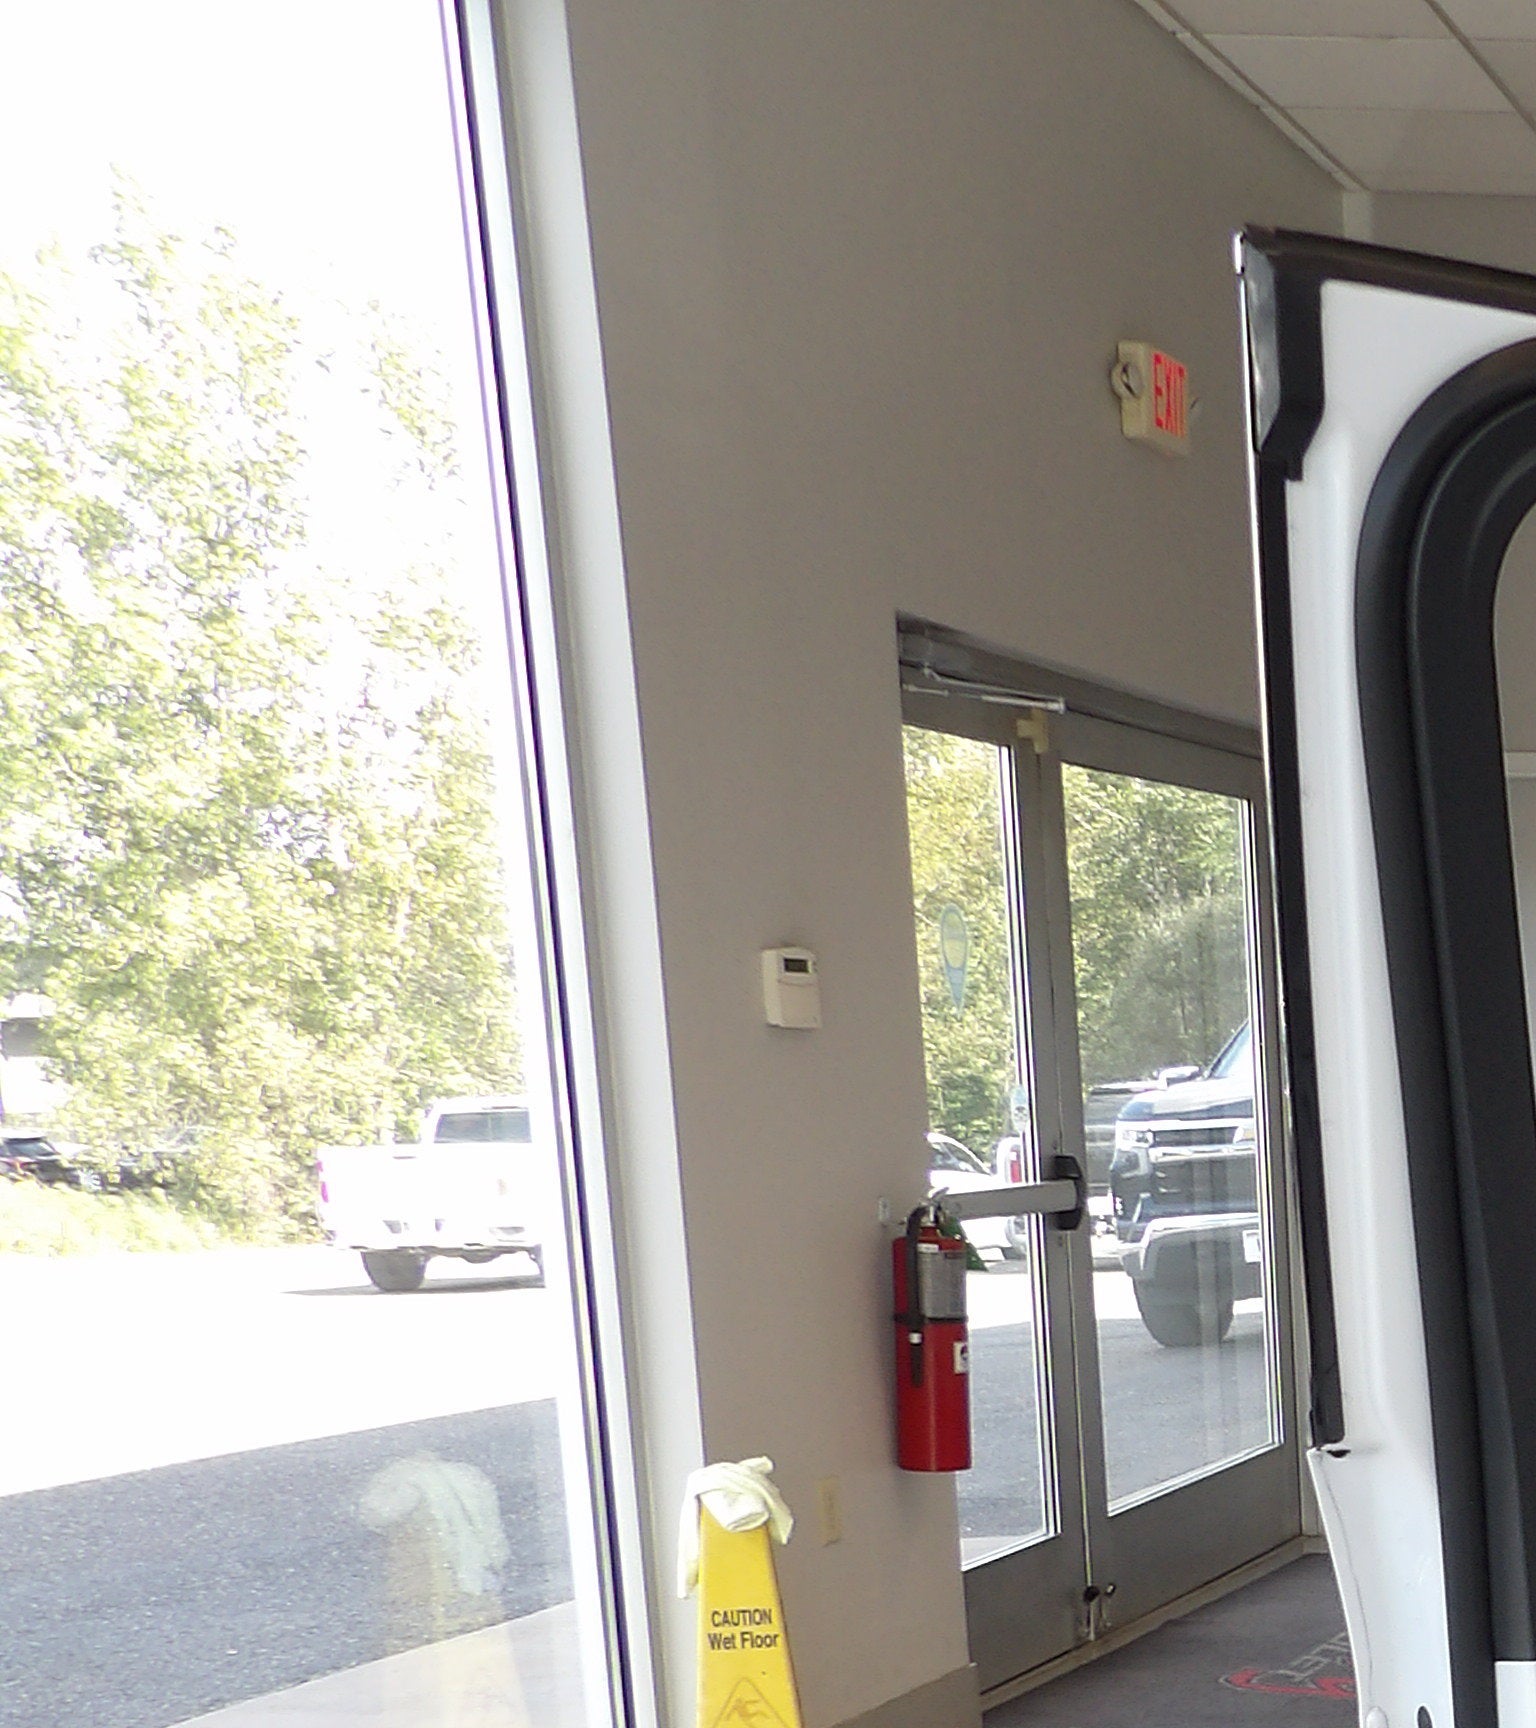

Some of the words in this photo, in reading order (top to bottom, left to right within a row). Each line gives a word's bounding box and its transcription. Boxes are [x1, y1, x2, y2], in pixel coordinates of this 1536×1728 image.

[1152, 352, 1186, 440] EXIT
[711, 1608, 773, 1628] CAUTION
[708, 1632, 737, 1651] Wet
[740, 1631, 780, 1650] Floor
